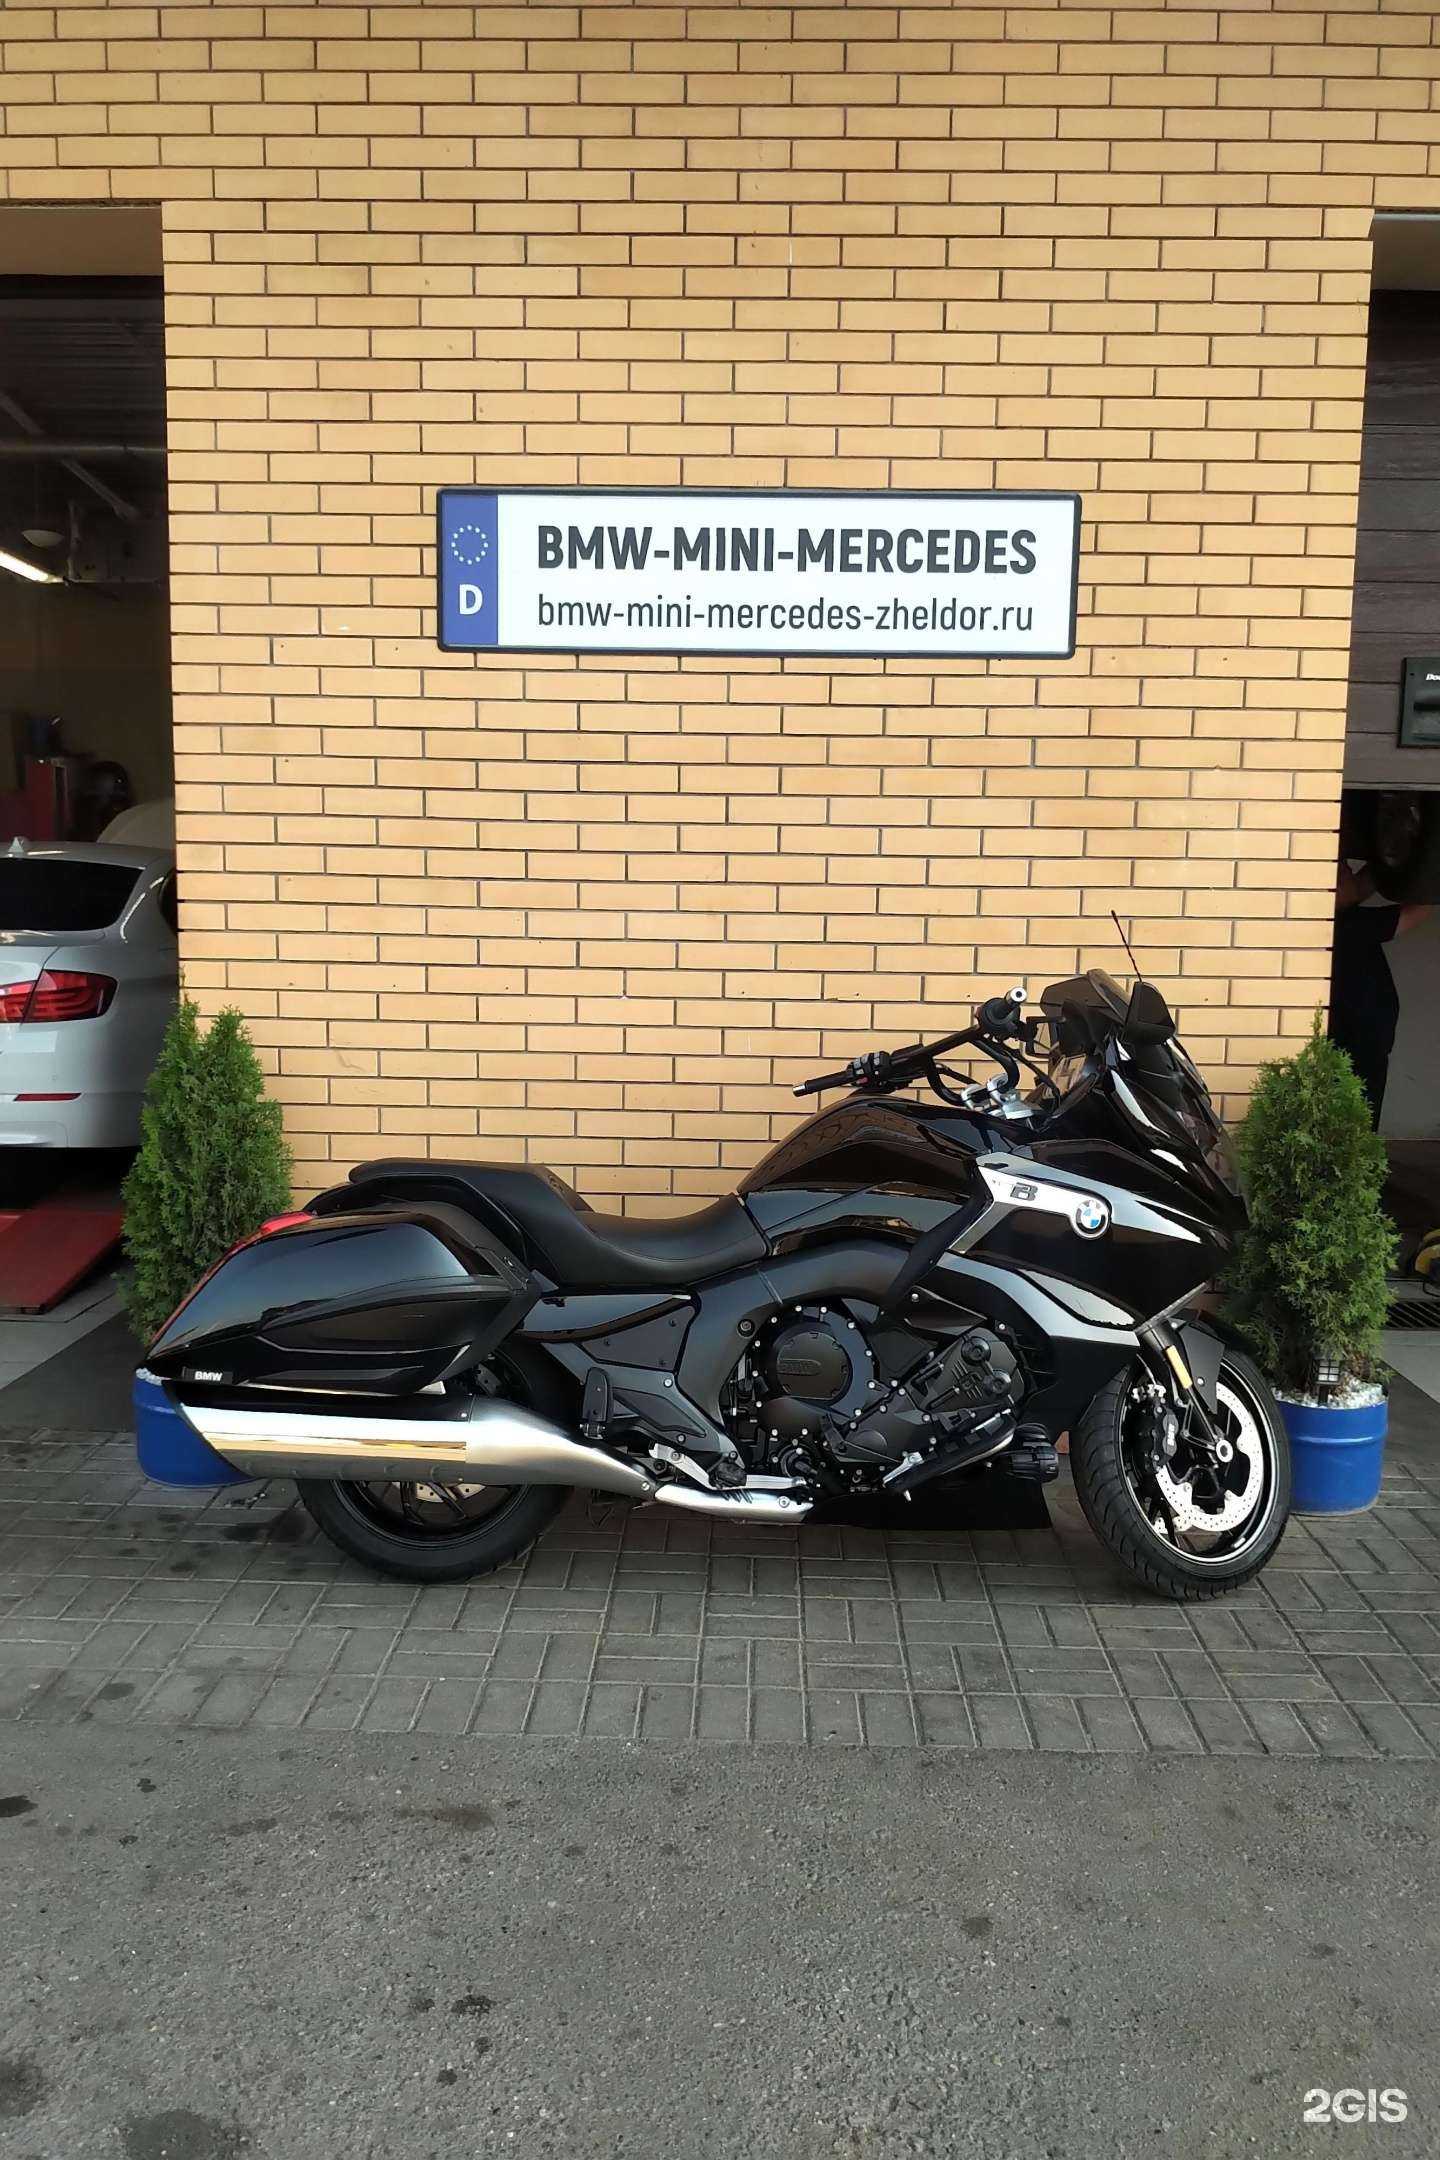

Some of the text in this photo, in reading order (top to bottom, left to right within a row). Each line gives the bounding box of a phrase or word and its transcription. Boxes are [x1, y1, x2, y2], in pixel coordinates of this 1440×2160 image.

[538, 525, 1037, 575] BMW-MINI-MERCEDES
[459, 584, 483, 615] D
[538, 593, 1033, 631] bmw-mini-mercedes-zheldor.ru
[194, 1370, 223, 1382] BMW
